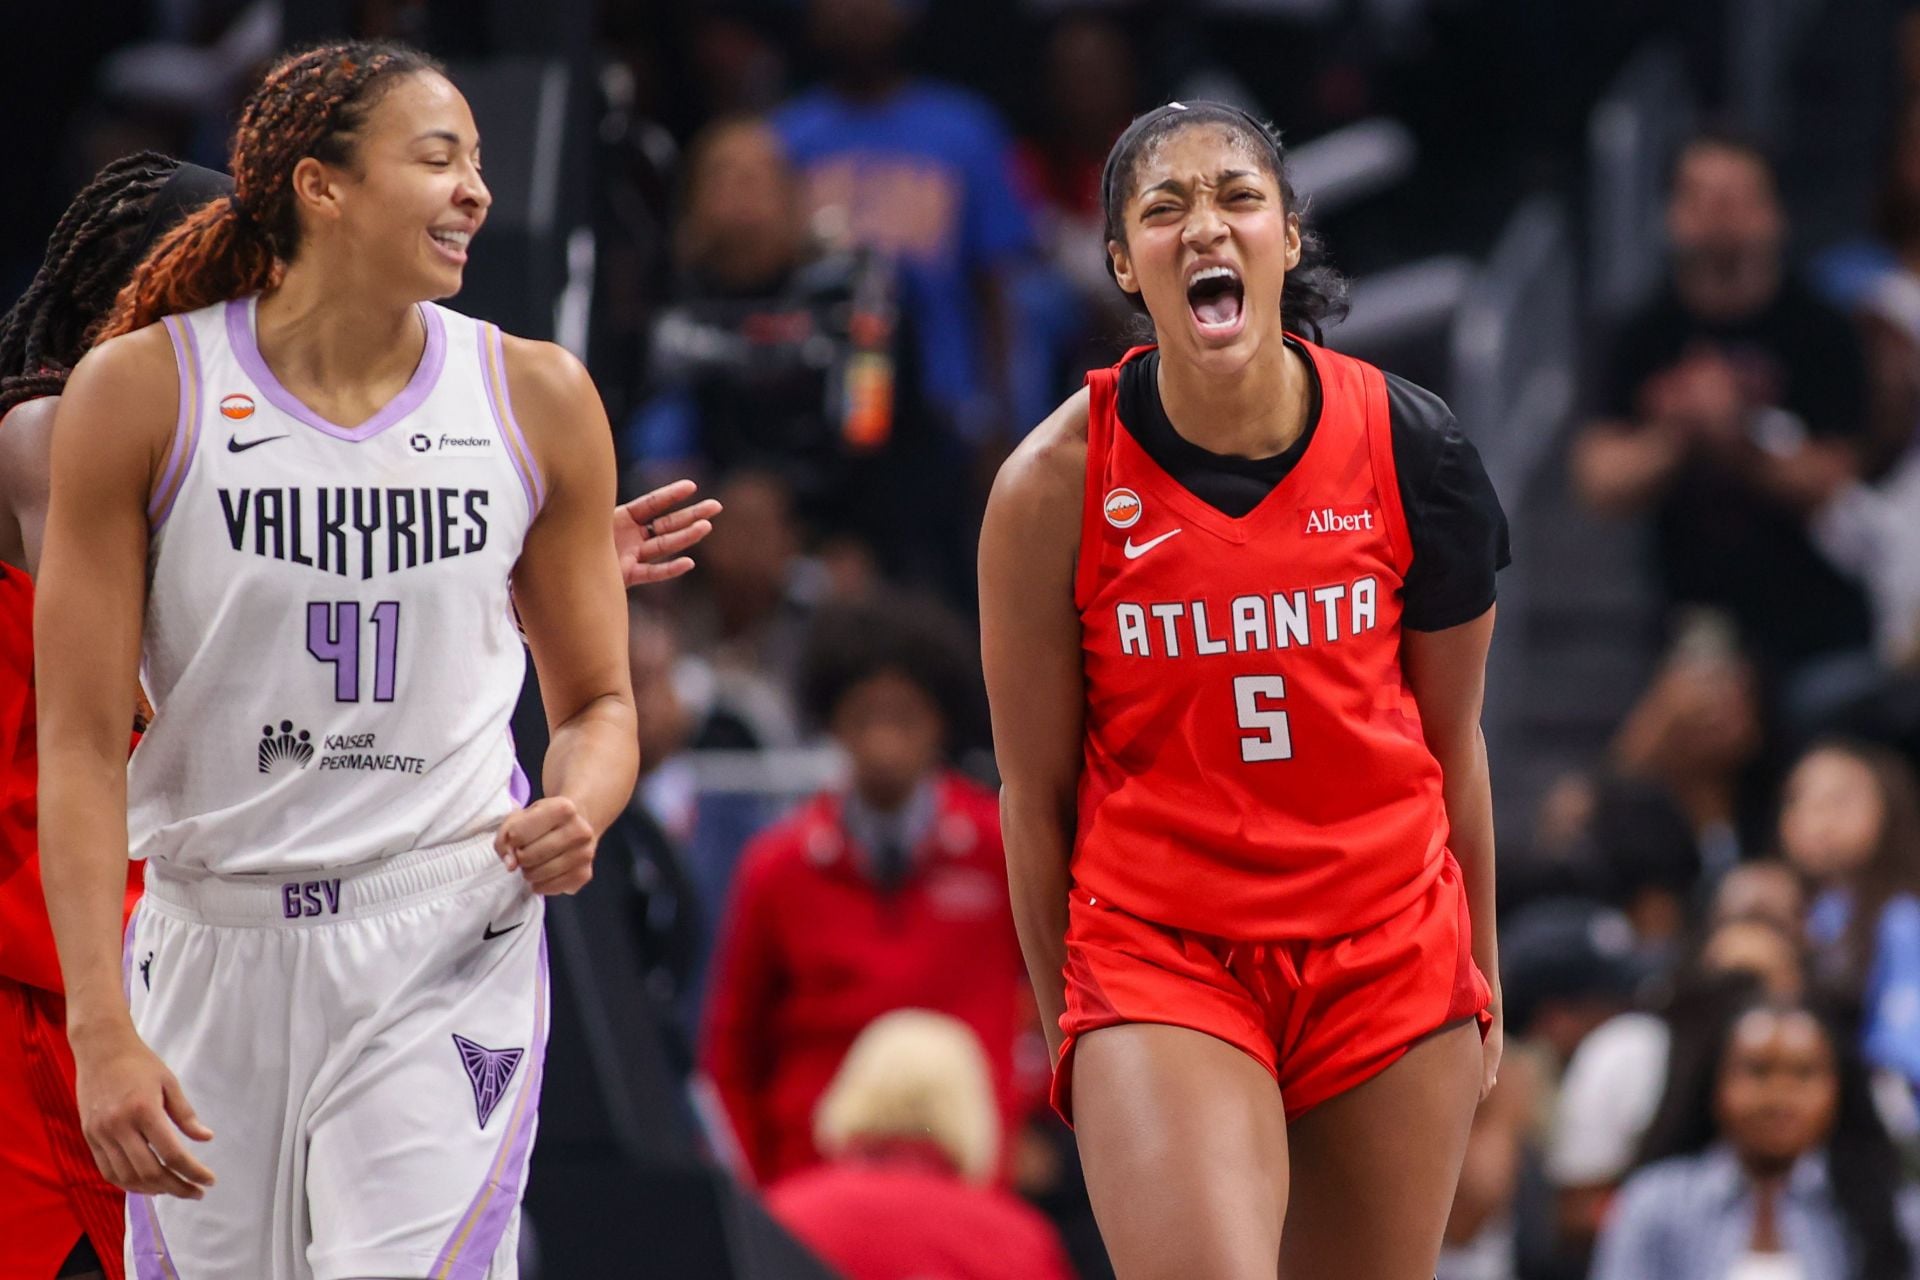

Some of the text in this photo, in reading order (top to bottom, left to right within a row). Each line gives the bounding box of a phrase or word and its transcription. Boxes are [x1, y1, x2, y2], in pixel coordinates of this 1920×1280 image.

[438, 433, 491, 449] freedom
[217, 487, 489, 580] VALKYRIES
[1305, 508, 1374, 534] Albert
[1116, 576, 1377, 658] ATLANTA
[306, 601, 400, 703] 41
[1233, 674, 1293, 763] 5
[323, 733, 376, 751] KAISER
[319, 754, 426, 775] PERMANENTE
[280, 878, 341, 919] GSV
